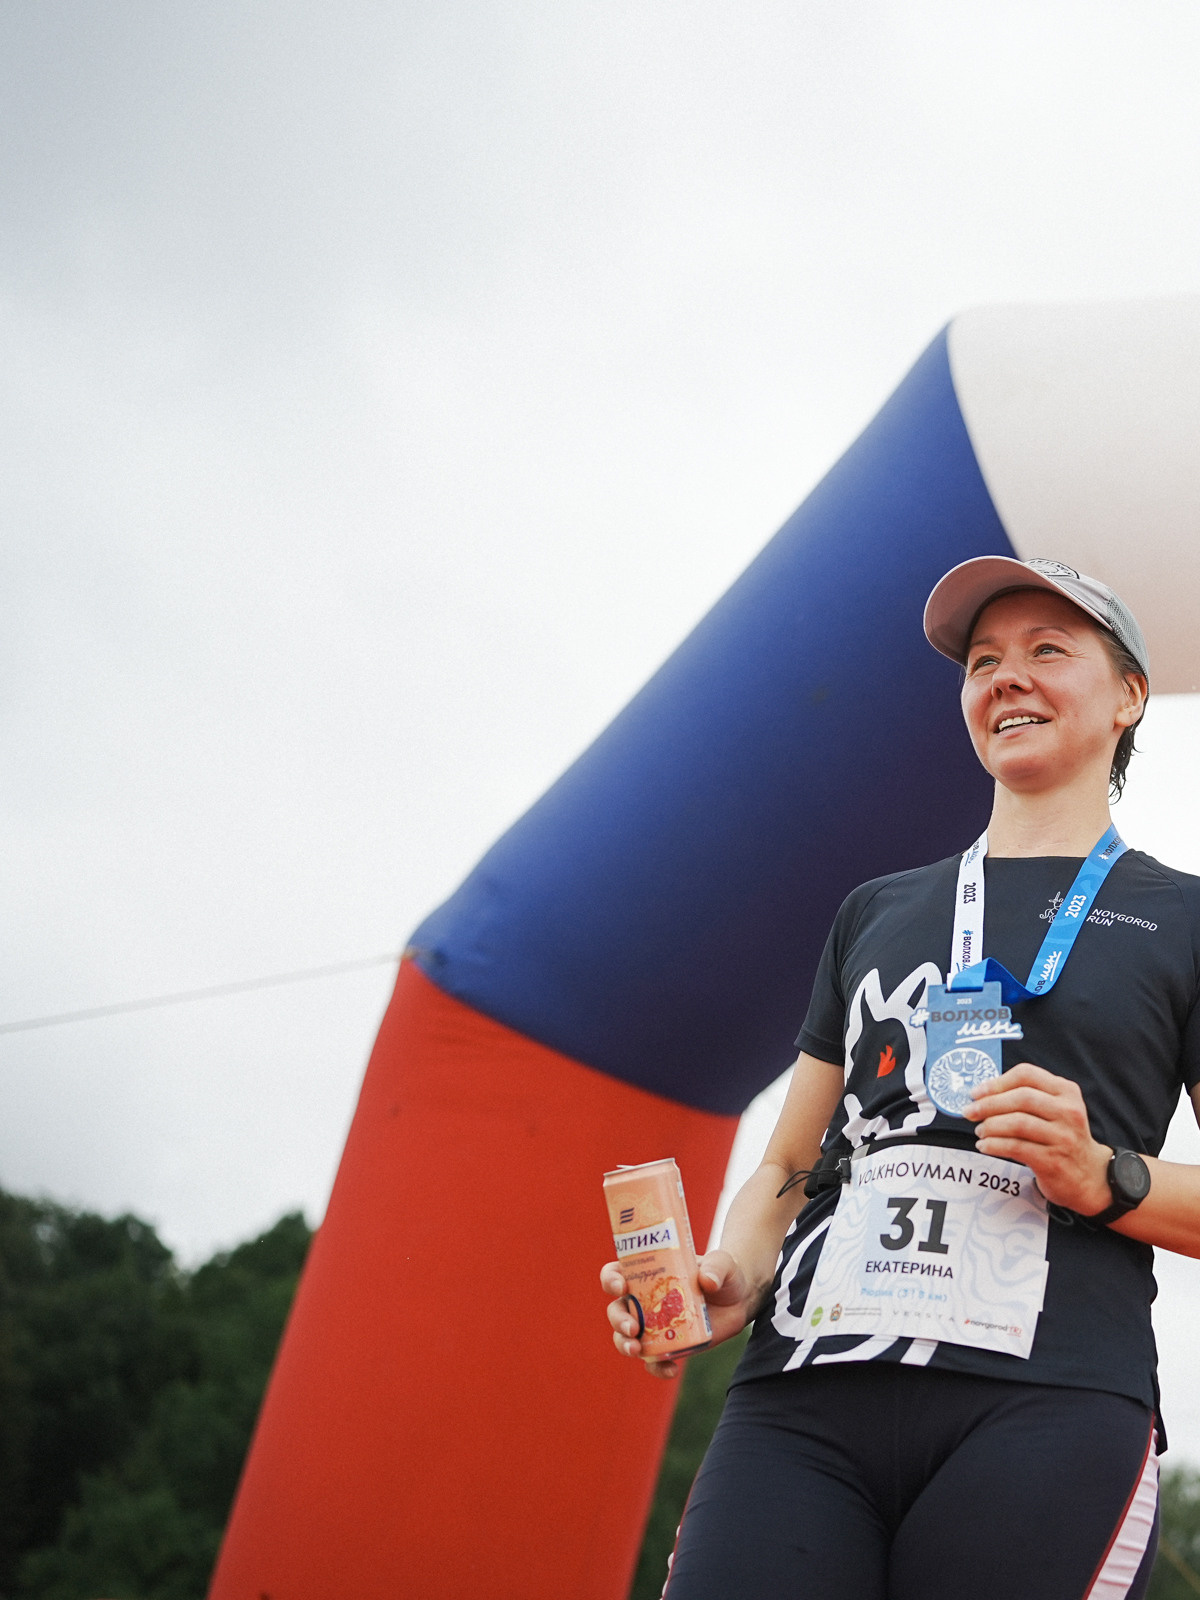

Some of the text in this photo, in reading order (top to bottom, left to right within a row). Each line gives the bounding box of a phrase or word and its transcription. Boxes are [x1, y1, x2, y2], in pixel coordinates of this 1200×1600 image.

[963, 882, 976, 904] 2023
[1065, 895, 1087, 918] 2023
[1086, 916, 1113, 926] RUN
[1092, 908, 1158, 931] NOVGOROD
[910, 1007, 1010, 1027] #ВОЛХОВ
[957, 1020, 1020, 1036] мен
[857, 1161, 1022, 1197] VOLKHOVMAN 2023
[879, 1196, 950, 1255] 31
[865, 1260, 954, 1280] ЕКАТЕРИНА
